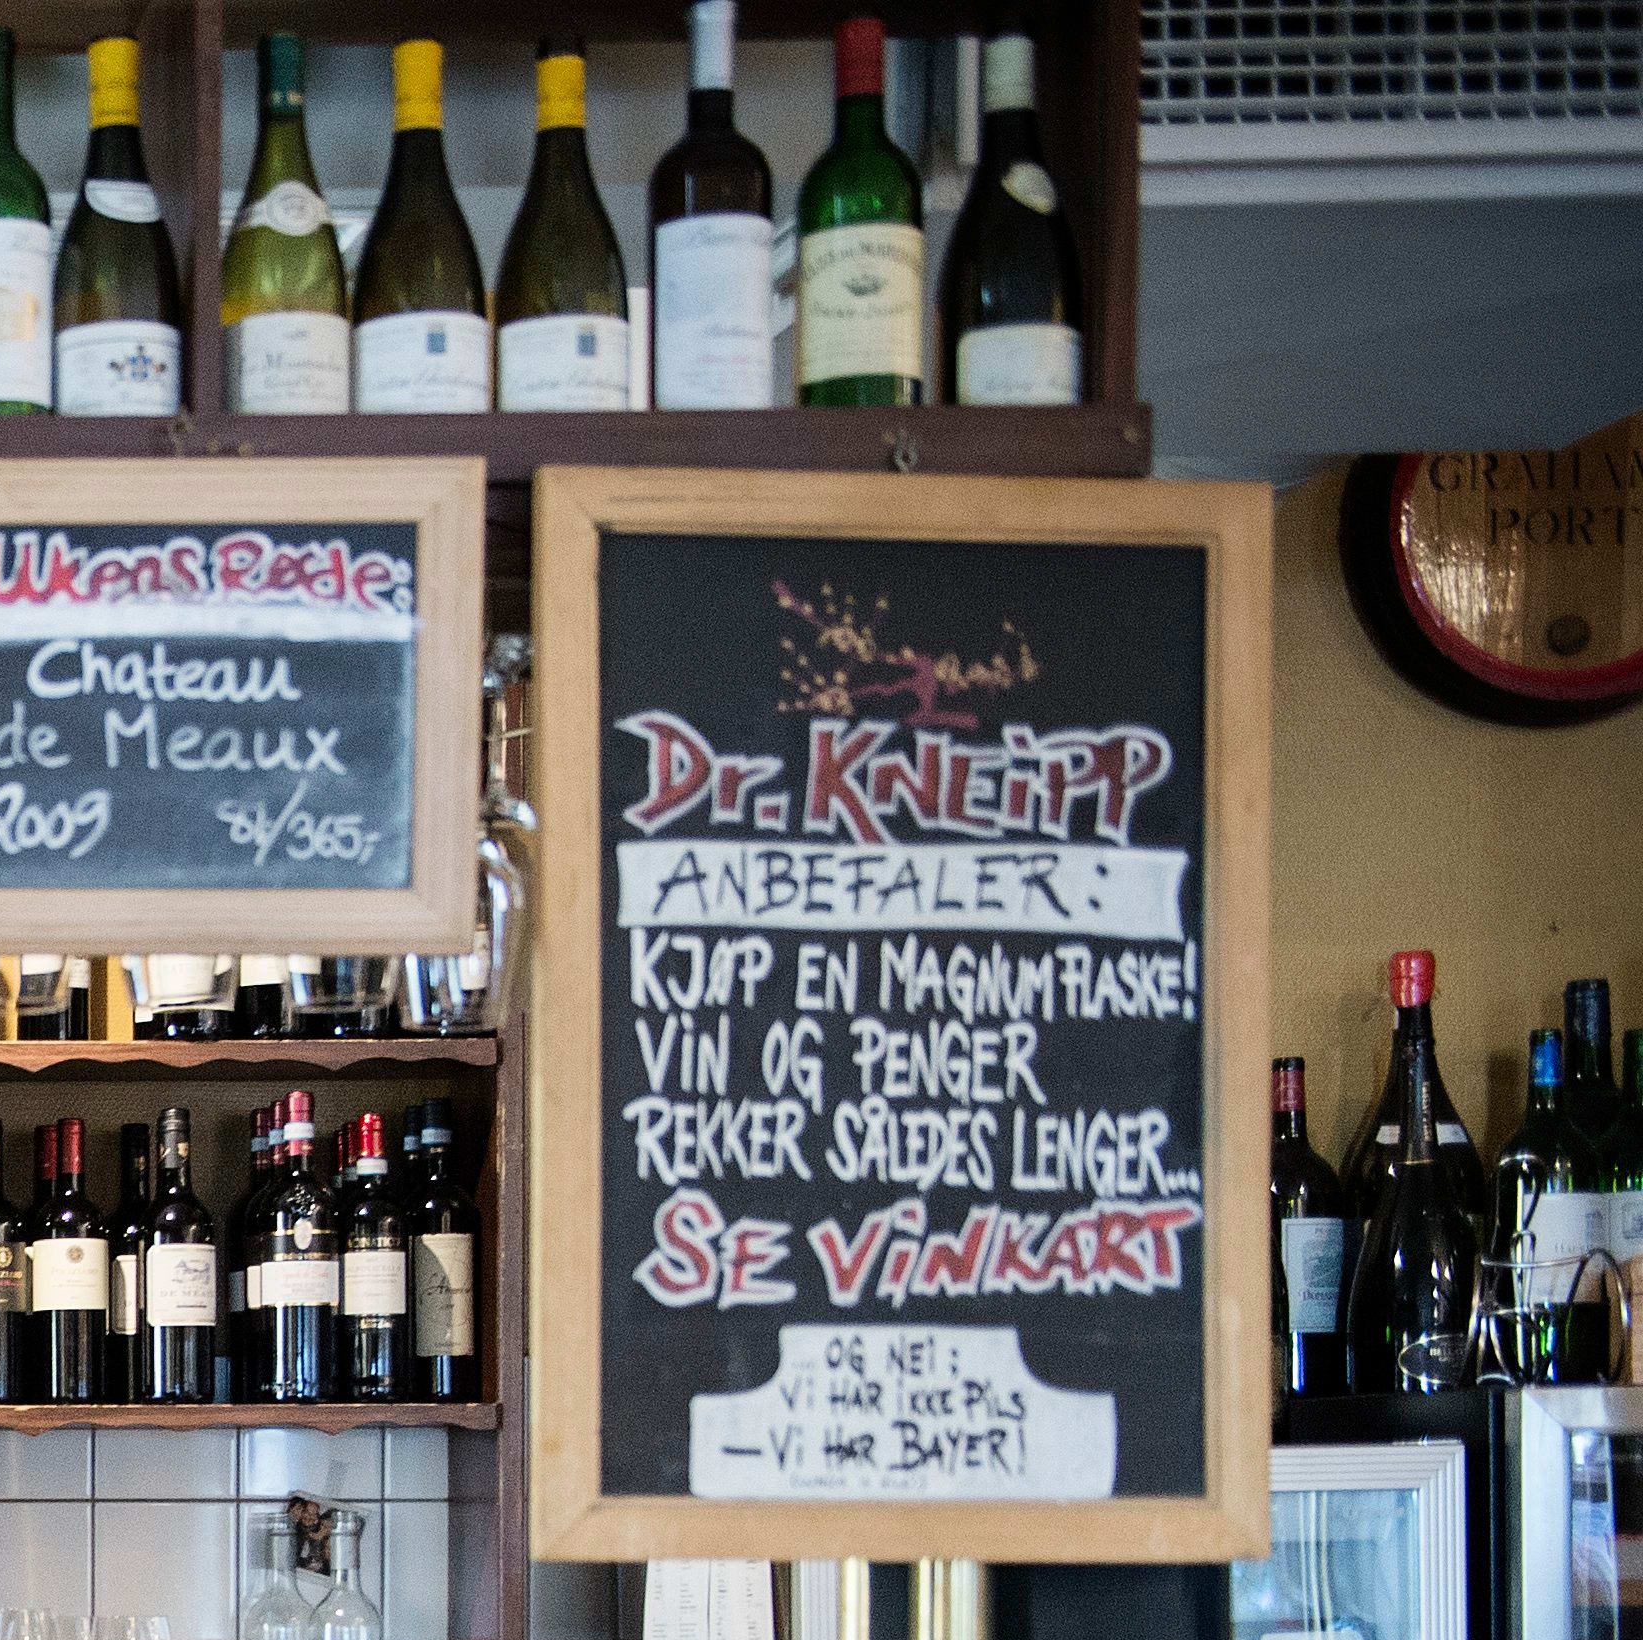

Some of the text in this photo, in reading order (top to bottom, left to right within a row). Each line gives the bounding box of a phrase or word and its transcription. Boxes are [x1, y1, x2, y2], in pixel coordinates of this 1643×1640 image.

[1489, 505, 1639, 546] PORT
[26, 640, 302, 702] Chateau
[104, 704, 347, 775] Meaux
[615, 710, 788, 834] Dr.
[654, 850, 1109, 918] ANBEFALER:
[629, 927, 775, 1010] KJØP
[798, 940, 858, 1011] EN
[762, 1021, 823, 1113] OG
[850, 1018, 1047, 1105] PENGER
[624, 1098, 814, 1185] REKKER
[827, 1096, 1002, 1194] SÅLEDES
[632, 1187, 797, 1309] SE
[825, 1335, 866, 1379] OG
[827, 1377, 883, 1416] HAR
[822, 1424, 878, 1468] HAR
[887, 1418, 1026, 1477] BAYER!
